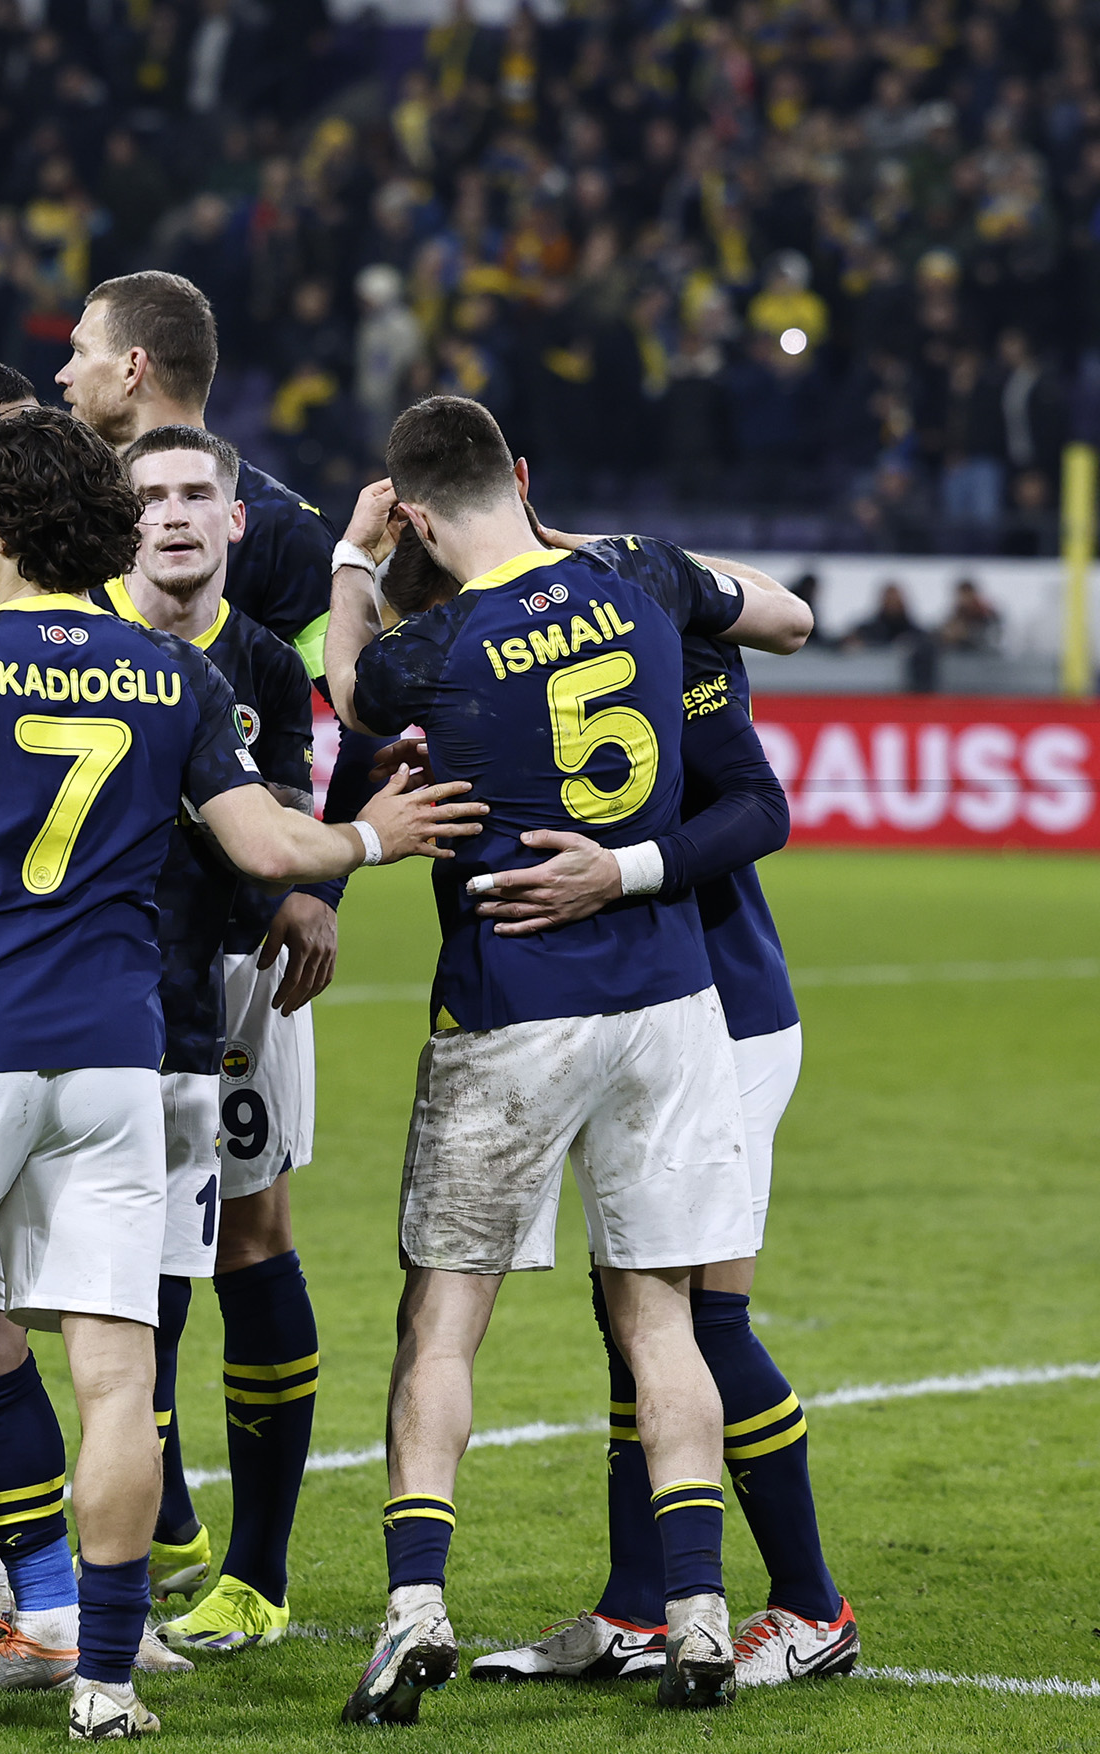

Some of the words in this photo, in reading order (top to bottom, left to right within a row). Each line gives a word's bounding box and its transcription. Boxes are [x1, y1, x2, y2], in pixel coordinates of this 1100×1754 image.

[546, 650, 660, 825] 5
[14, 713, 133, 895] 7
[221, 1088, 269, 1160] 9
[195, 1173, 217, 1246] 1
